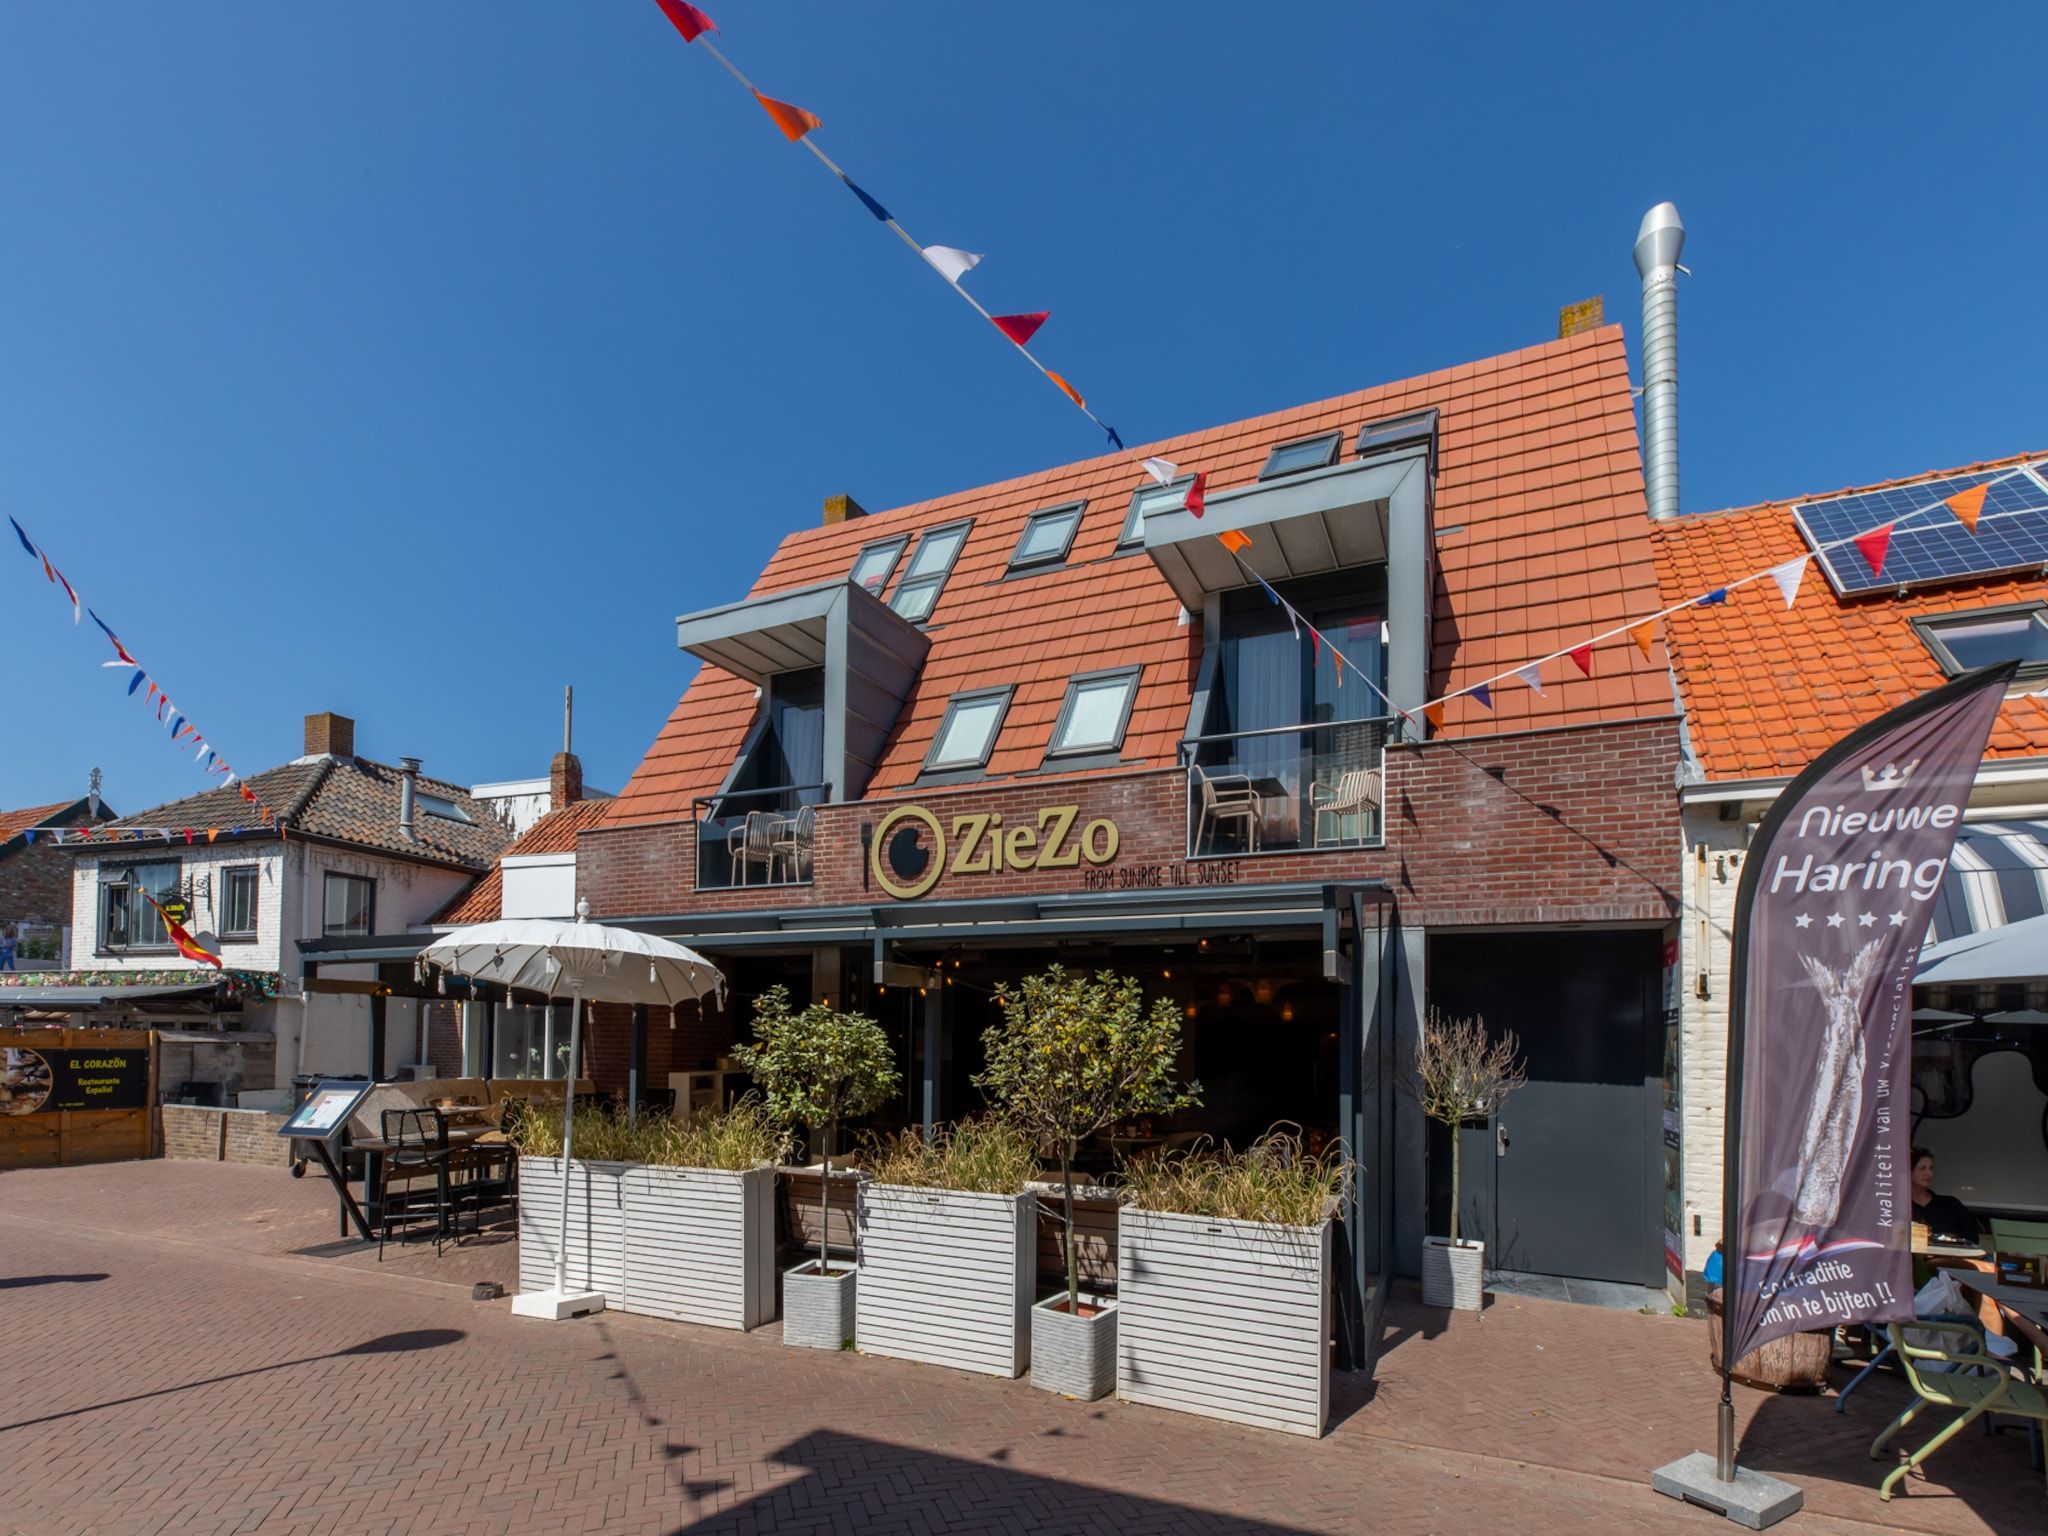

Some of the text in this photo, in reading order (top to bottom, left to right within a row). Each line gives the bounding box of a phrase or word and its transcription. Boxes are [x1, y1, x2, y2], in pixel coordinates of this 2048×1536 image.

[951, 805, 1120, 874] ZieZo
[1085, 862, 1240, 889] FROM SUNRISE TILL SUNSET
[1771, 851, 1948, 901] Haring
[70, 1060, 81, 1069] EL
[1877, 1079, 1890, 1098] uw
[1877, 1107, 1890, 1133] van
[1874, 1144, 1892, 1227] kwaliteit
[1789, 1260, 1854, 1288] traditie
[1759, 1282, 1896, 1327] om in te bijten !!
